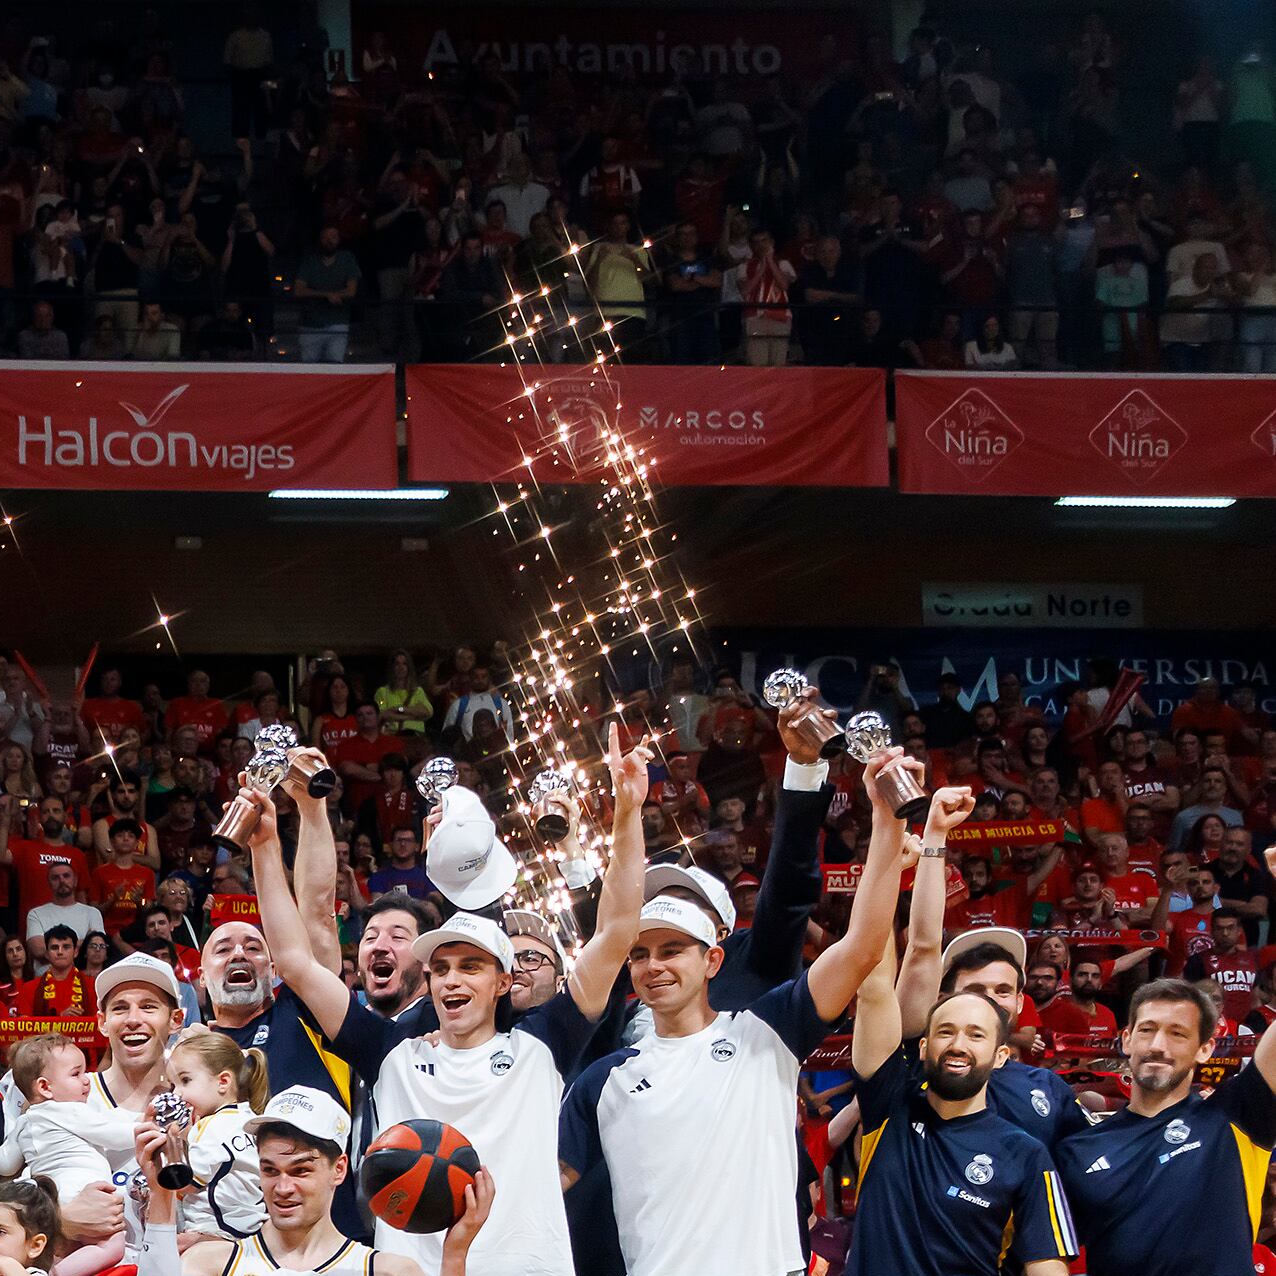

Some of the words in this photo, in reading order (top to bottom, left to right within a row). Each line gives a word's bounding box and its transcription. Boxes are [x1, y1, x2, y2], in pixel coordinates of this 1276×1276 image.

[945, 430, 1008, 455] Niña
[1108, 432, 1169, 457] Niña
[201, 443, 295, 479] viajes
[1049, 594, 1132, 617] Norte
[1025, 657, 1270, 687] UNERSIDA
[986, 826, 1035, 838] MURCIA
[40, 854, 72, 864] TOMMY
[17, 1020, 50, 1033] UCAM
[51, 1021, 96, 1033] MURCIA
[958, 1190, 991, 1209] Sanitas
